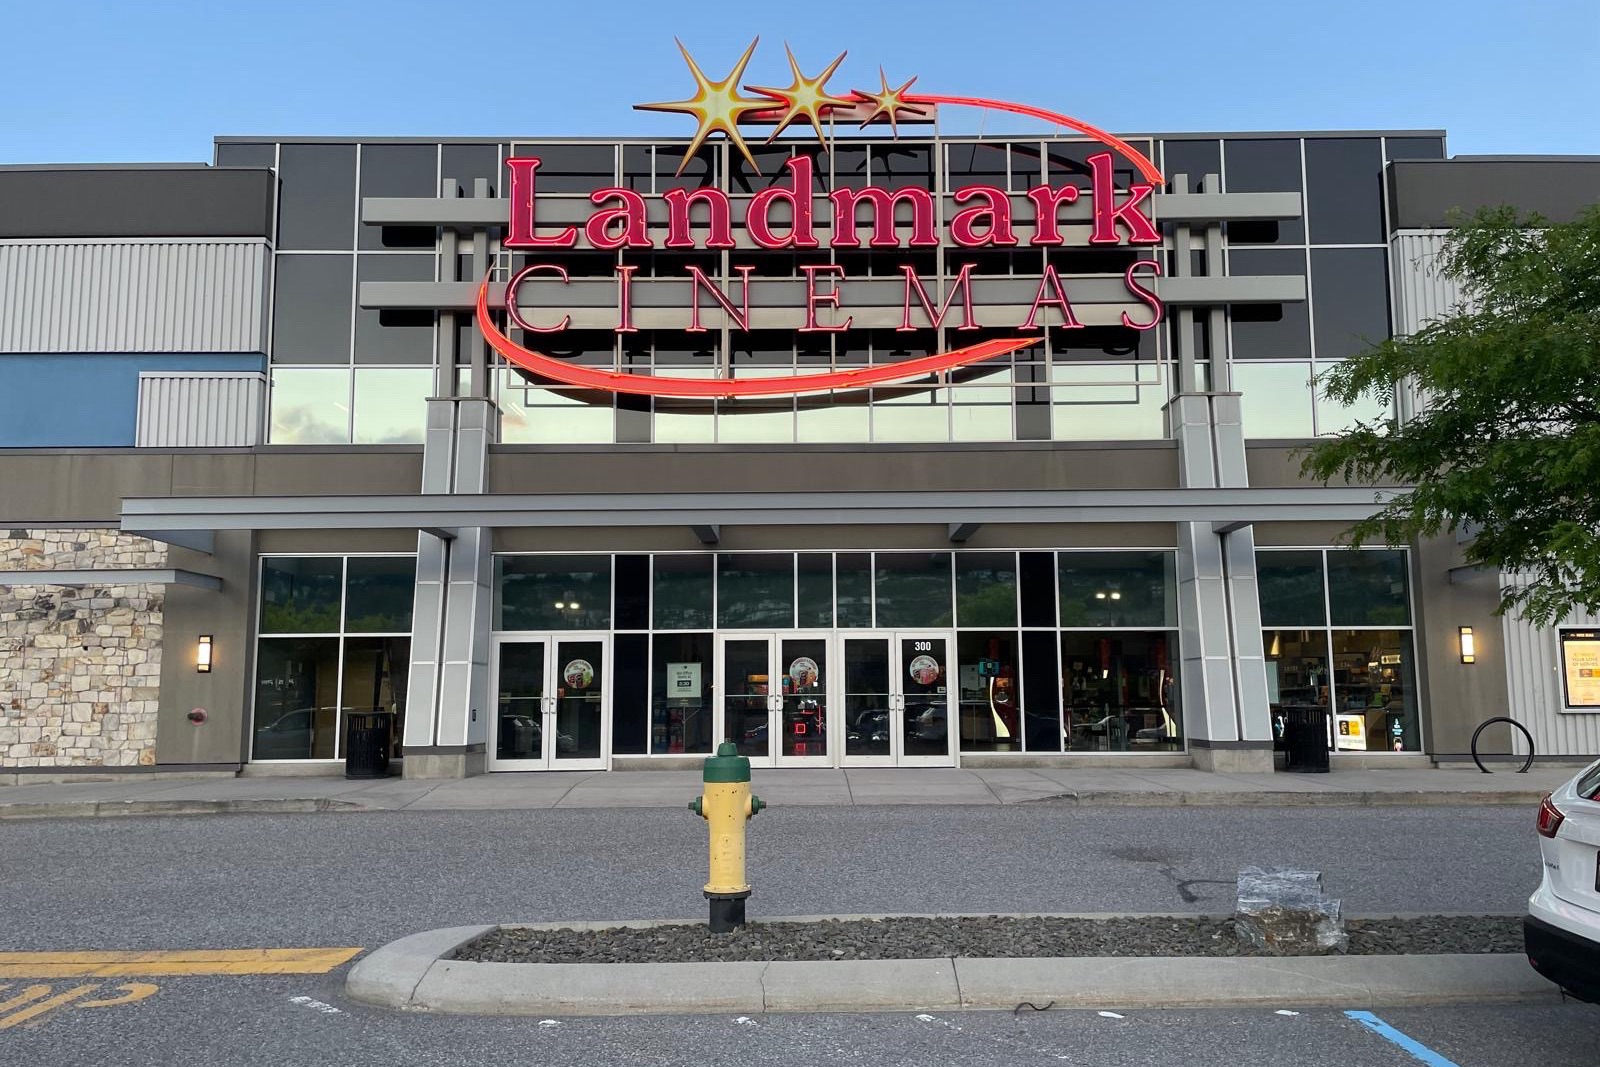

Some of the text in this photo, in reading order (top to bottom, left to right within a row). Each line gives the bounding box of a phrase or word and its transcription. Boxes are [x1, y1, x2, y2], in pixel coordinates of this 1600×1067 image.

[502, 152, 1166, 250] Landmark
[503, 260, 1166, 334] CINEMAS
[914, 641, 932, 651] 300
